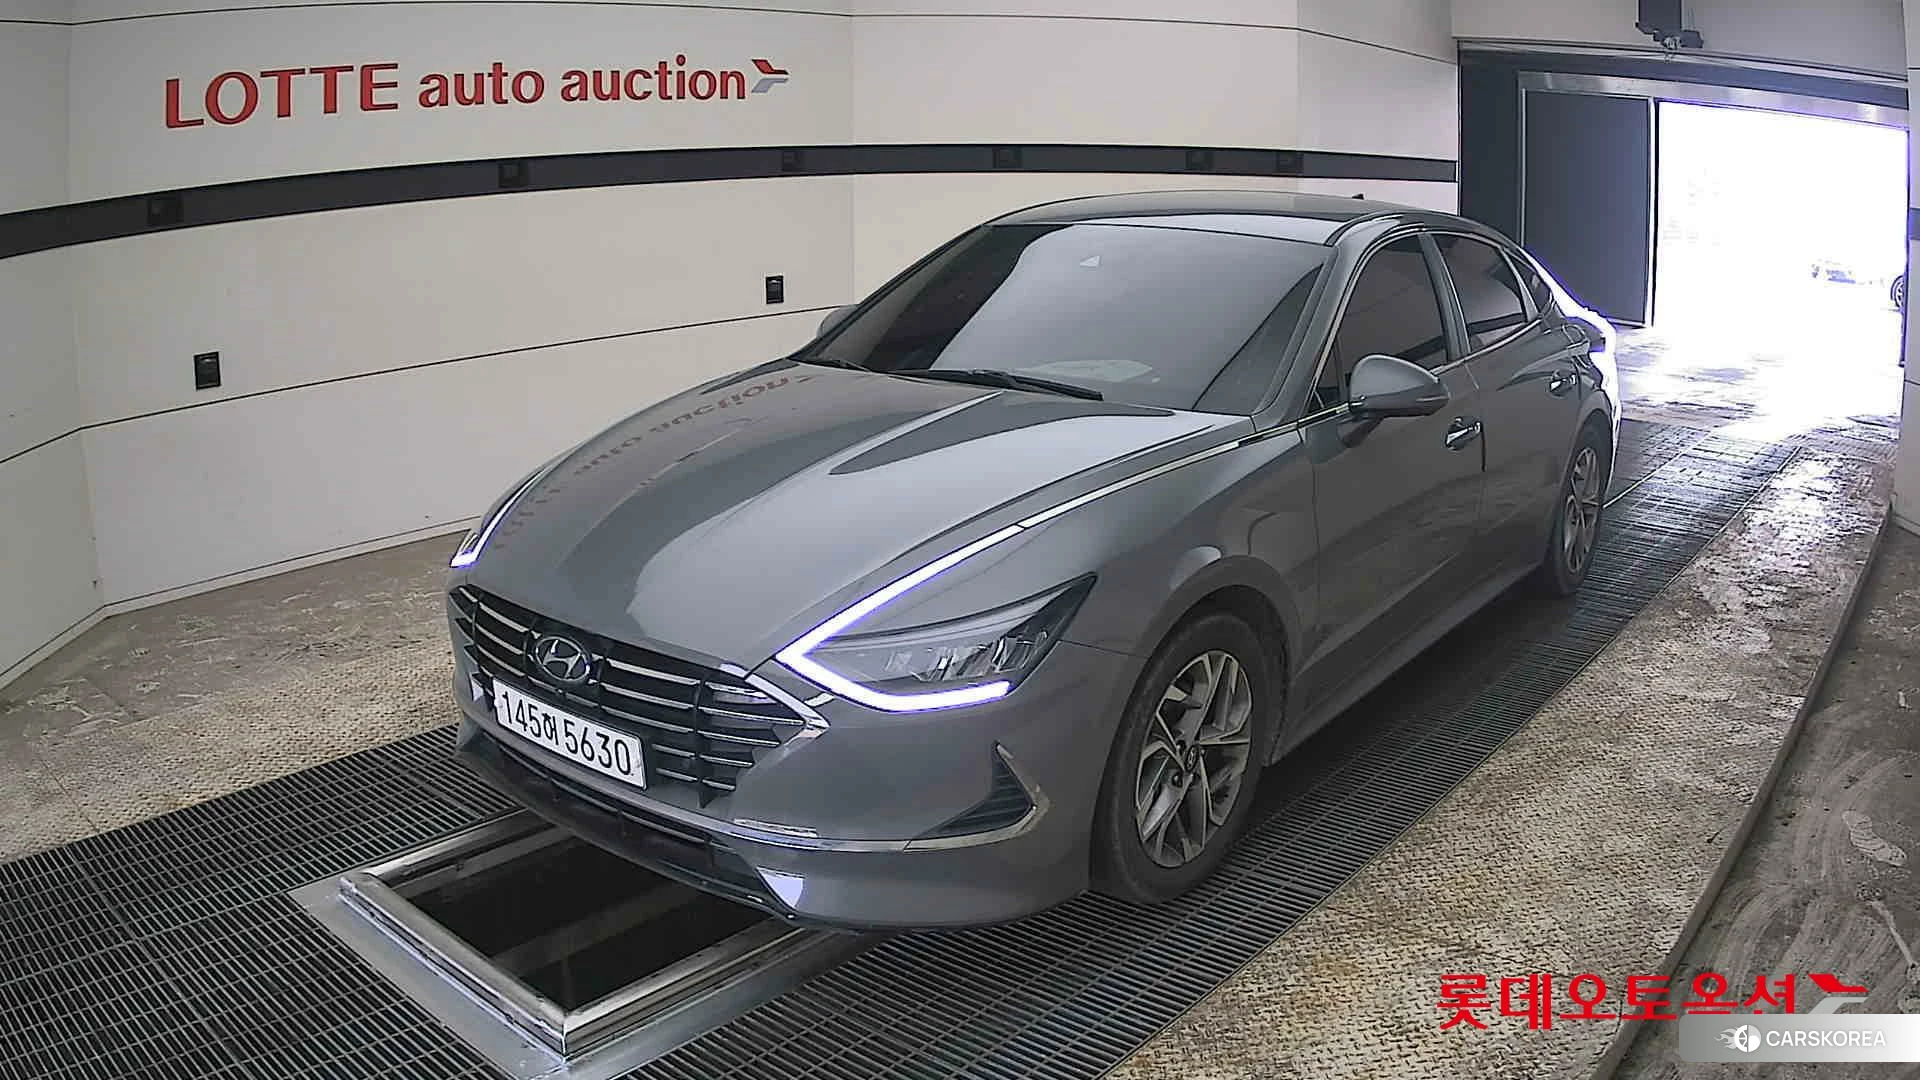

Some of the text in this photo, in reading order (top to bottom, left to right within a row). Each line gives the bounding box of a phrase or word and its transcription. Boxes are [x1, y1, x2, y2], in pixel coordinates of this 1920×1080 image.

[165, 54, 747, 129] LOTTE auto auction
[563, 718, 632, 776] 5630
